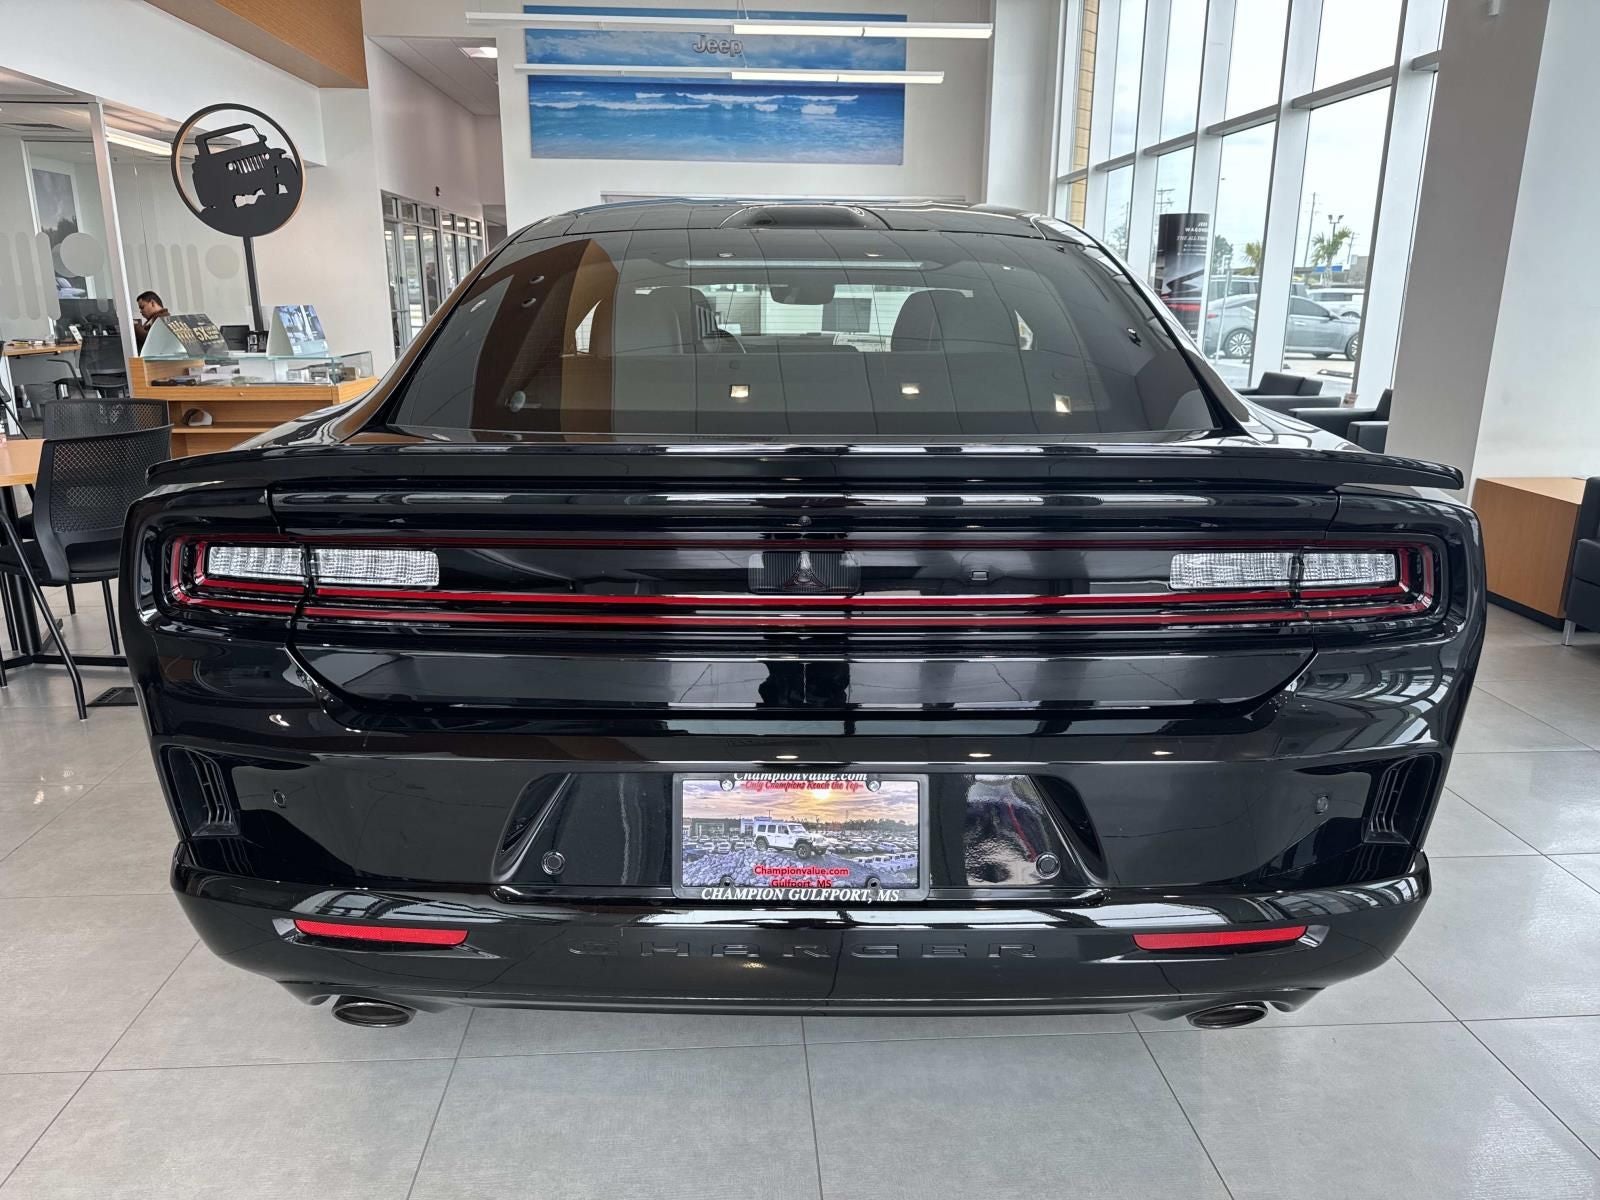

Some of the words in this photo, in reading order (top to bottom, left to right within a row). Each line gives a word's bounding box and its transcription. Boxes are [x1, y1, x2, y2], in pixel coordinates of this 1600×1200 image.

[692, 34, 743, 57] Jeep
[765, 780, 806, 792] Champions
[807, 780, 830, 790] Reach
[831, 780, 843, 790] the
[754, 866, 849, 877] Championvalue.com
[817, 879, 832, 888] MS
[701, 887, 784, 901] CHAMPION
[788, 887, 873, 904] GULFPORT,
[877, 888, 900, 902] MS
[567, 940, 1037, 959] CHARGER
